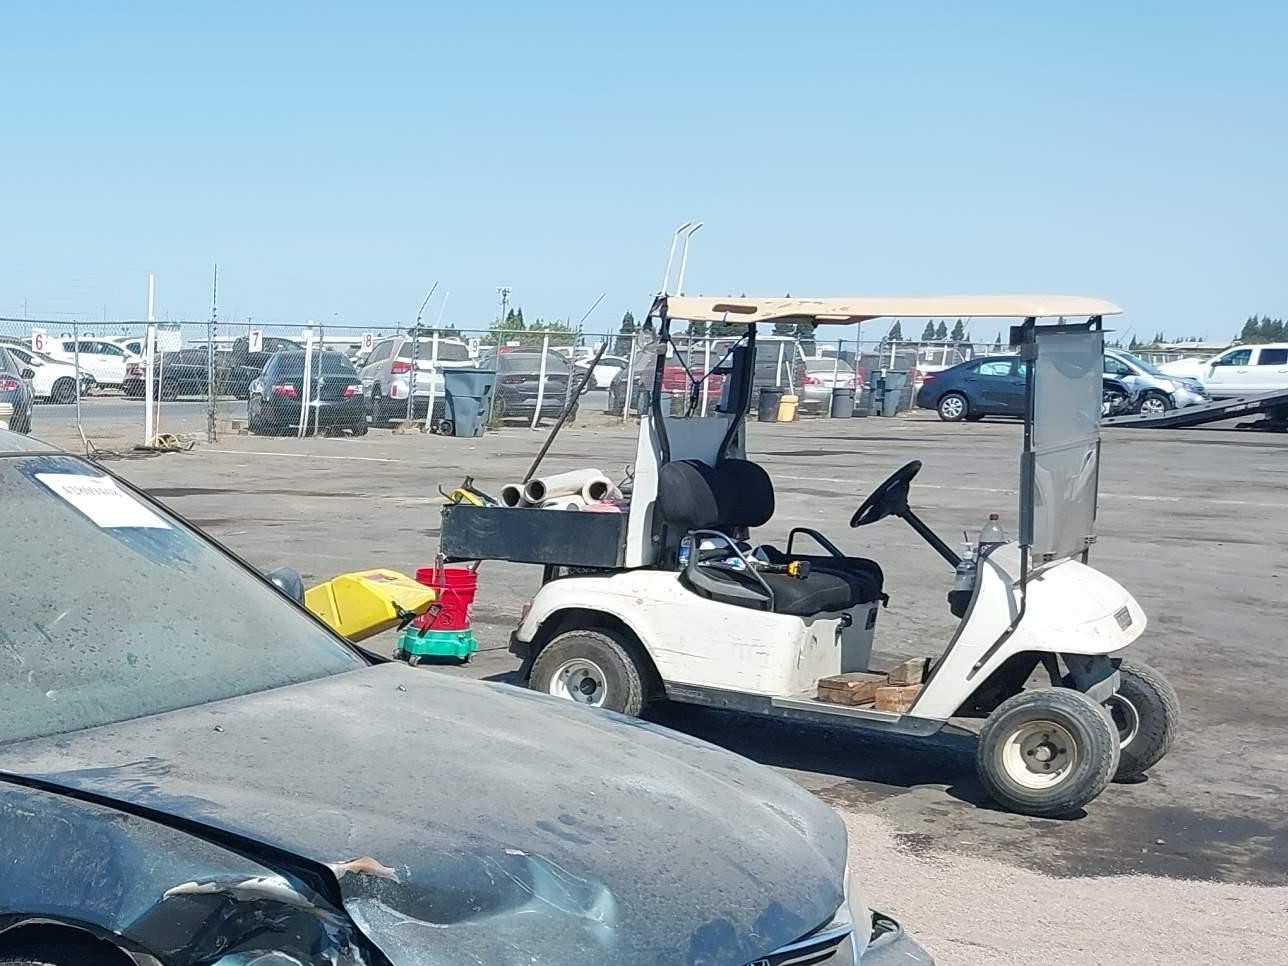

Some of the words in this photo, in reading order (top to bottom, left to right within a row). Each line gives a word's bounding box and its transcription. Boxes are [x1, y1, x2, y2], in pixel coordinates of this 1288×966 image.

[35, 333, 44, 351] 6
[251, 331, 260, 347] 7
[364, 333, 373, 348] 8
[471, 339, 479, 353] 9
